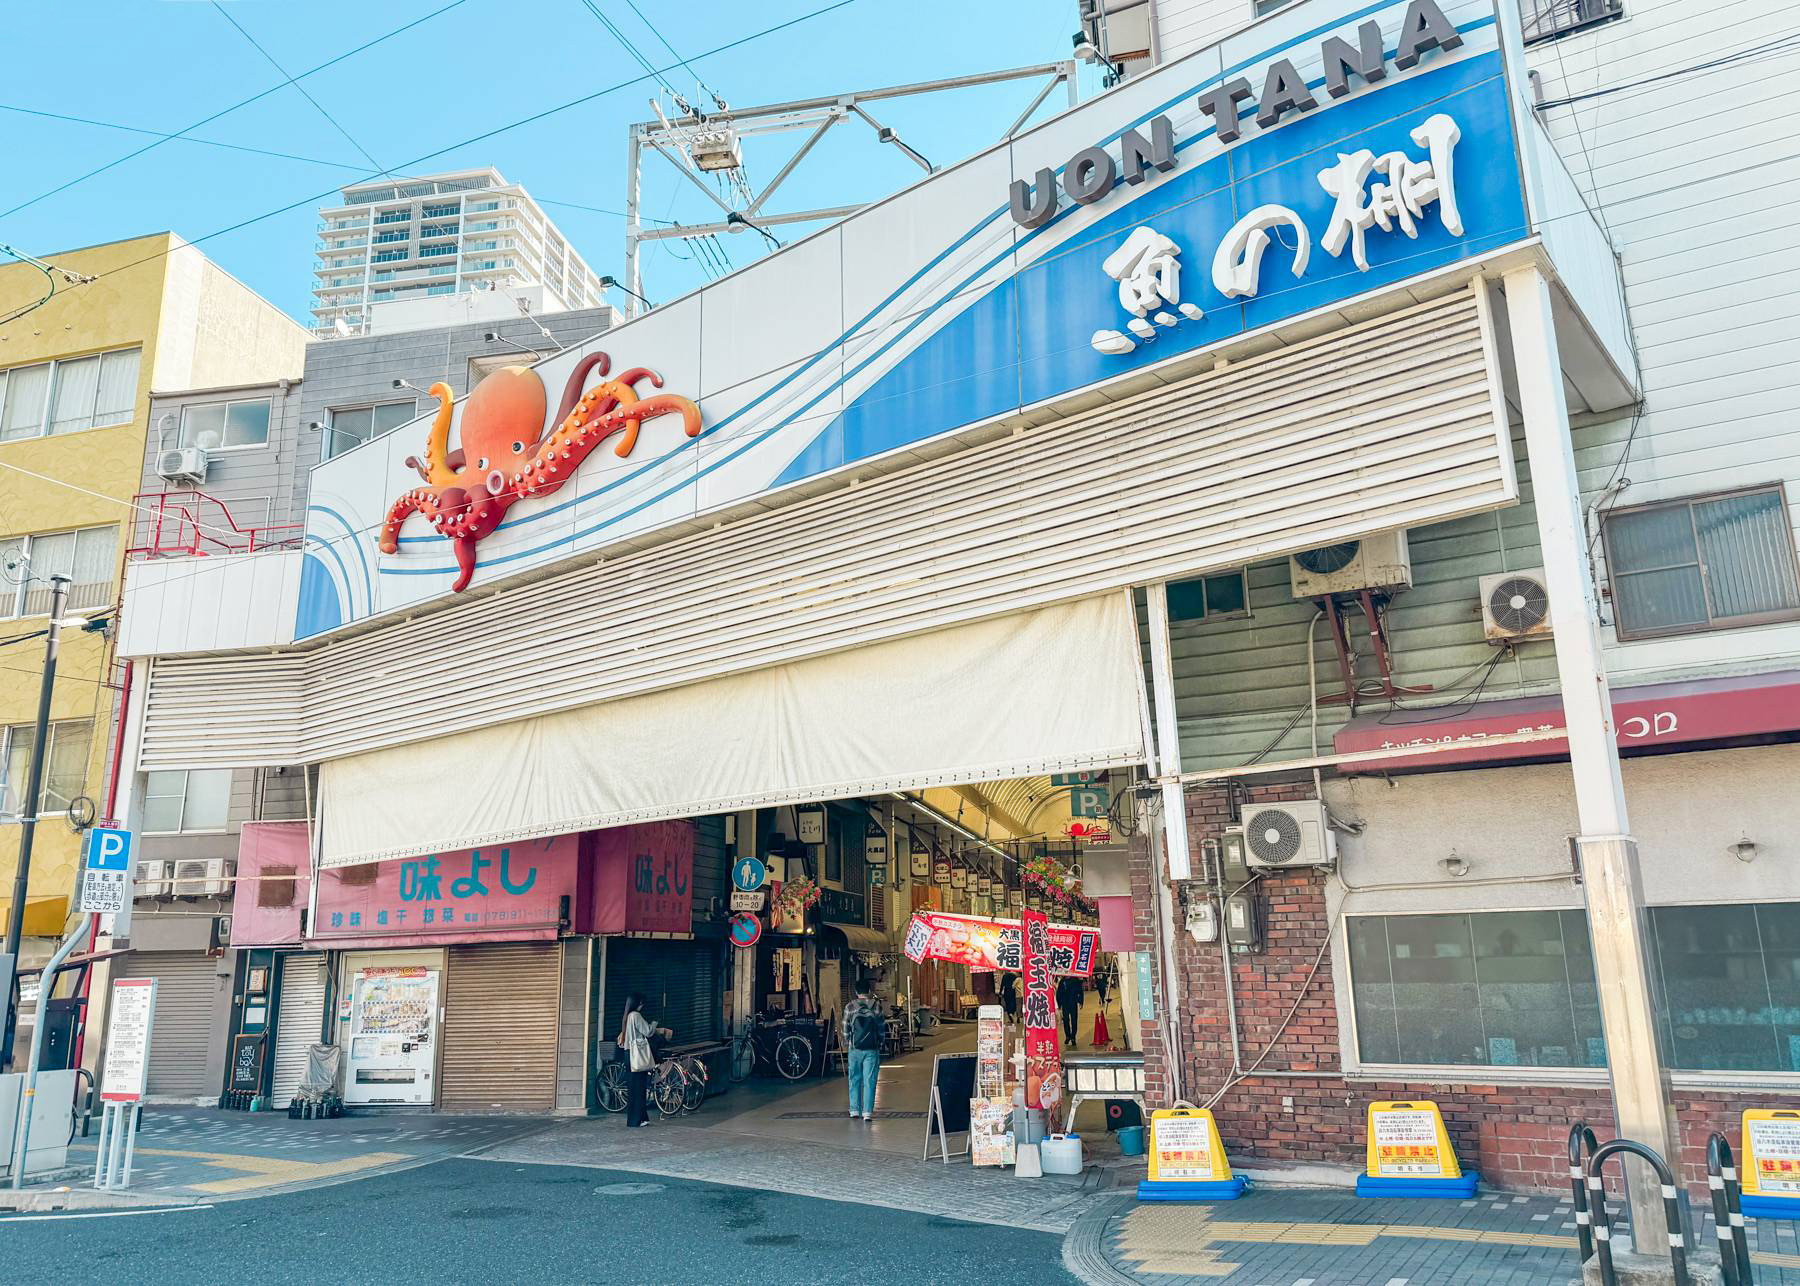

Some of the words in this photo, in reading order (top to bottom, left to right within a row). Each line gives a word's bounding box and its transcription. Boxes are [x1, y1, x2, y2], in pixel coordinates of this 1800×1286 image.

[1009, 114, 1178, 230] UON
[1198, 0, 1465, 144] TANA
[1091, 113, 1465, 356] 魚の棚
[1079, 792, 1098, 815] P
[98, 832, 124, 865] P
[87, 872, 124, 882] 自転車
[399, 847, 537, 901] 味よし
[635, 849, 688, 896] 味よし
[84, 901, 121, 910] ここから
[1036, 1040, 1054, 1054] 半熟
